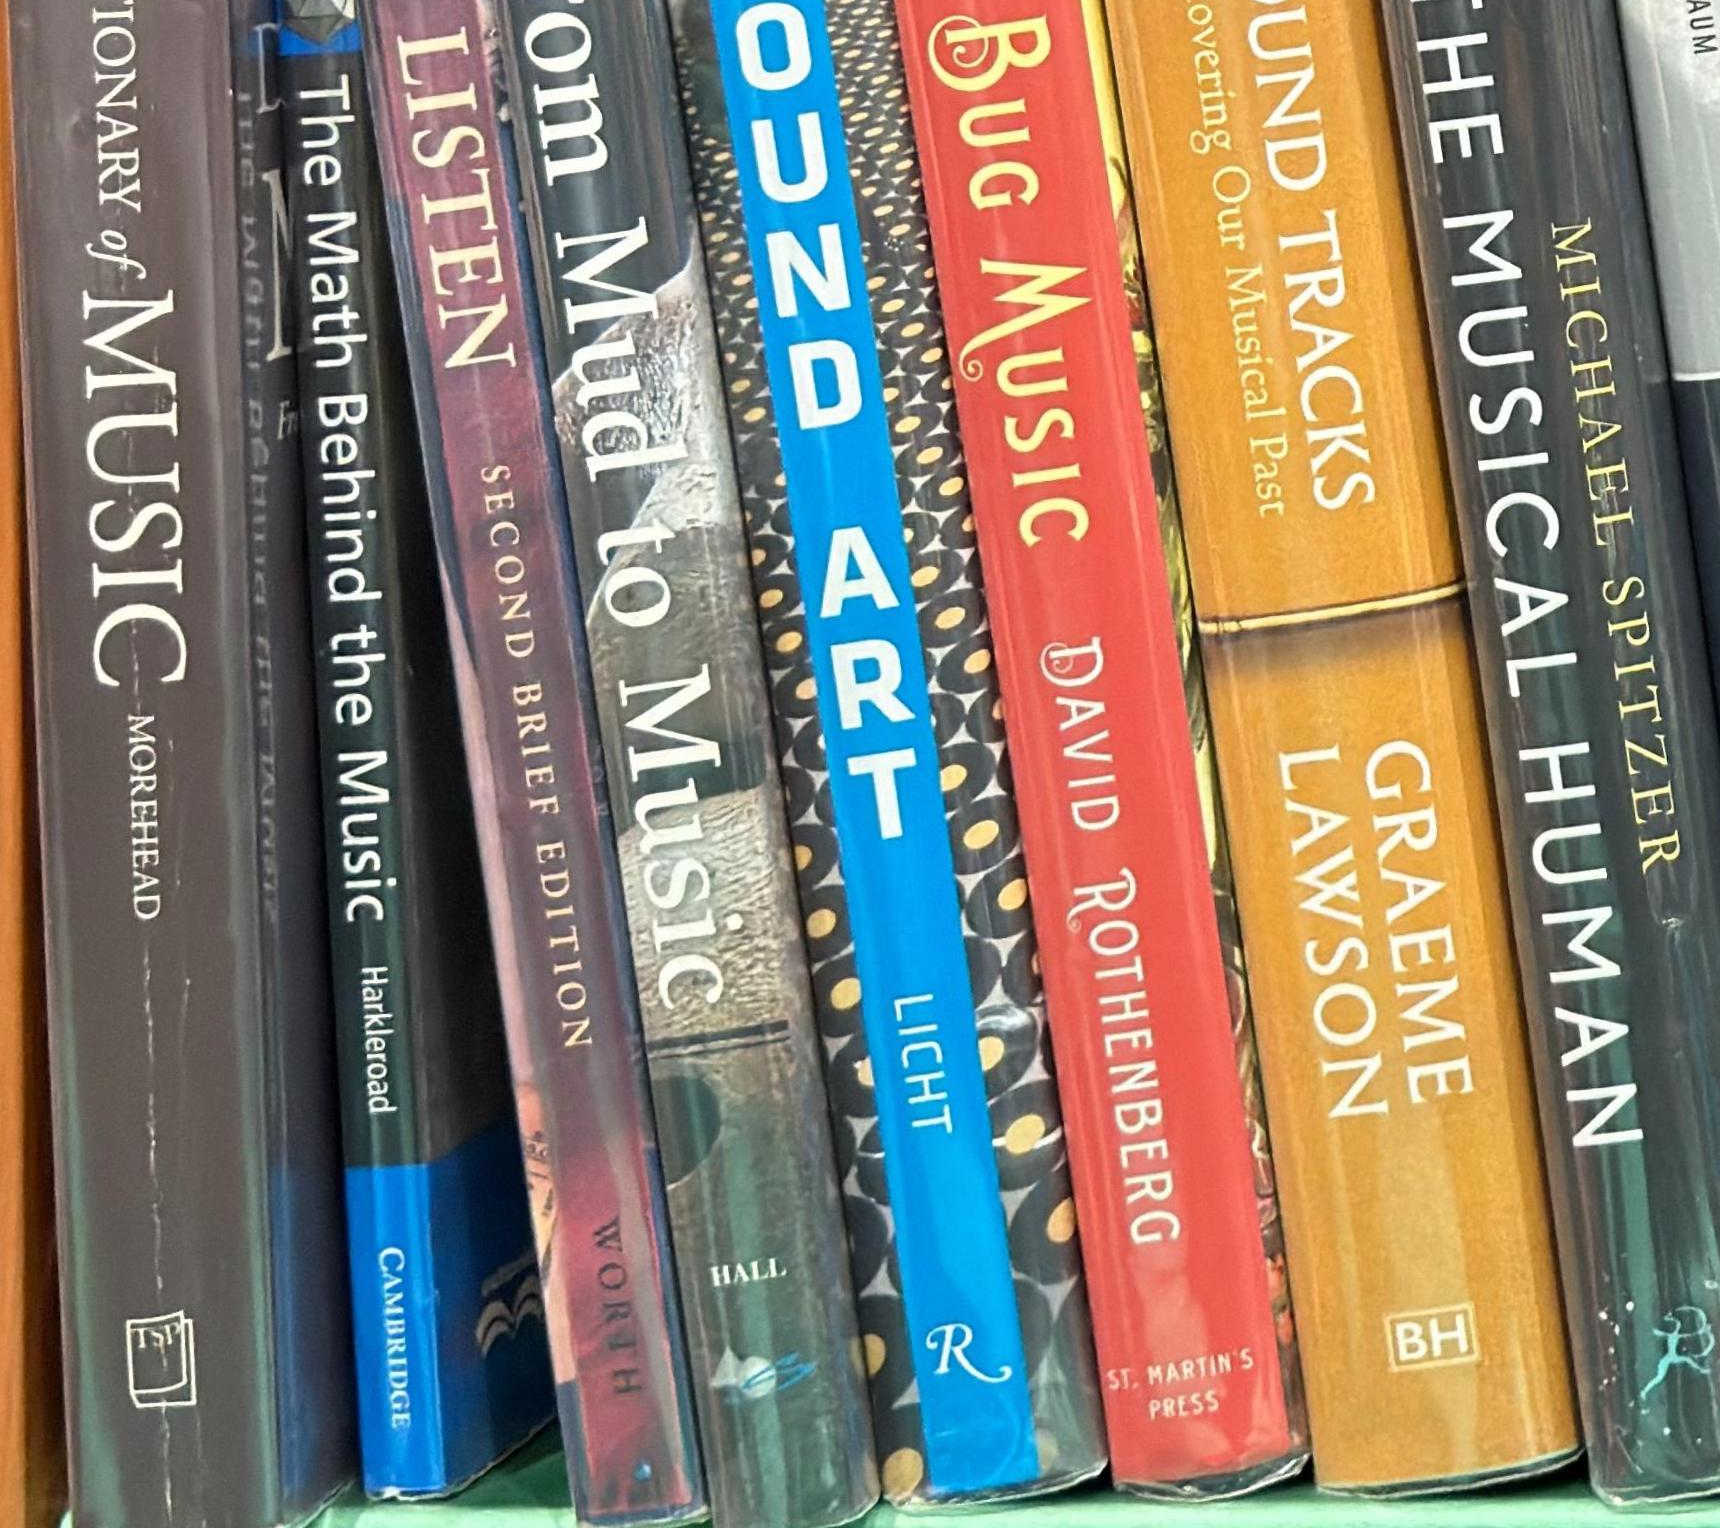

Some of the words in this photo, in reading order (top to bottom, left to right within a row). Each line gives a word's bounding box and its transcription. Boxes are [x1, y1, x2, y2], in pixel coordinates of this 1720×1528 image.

[296, 76, 351, 198] The
[395, 26, 515, 367] LISTEN
[1213, 165, 1253, 252] Our
[88, 229, 147, 280] of
[305, 212, 366, 368] Math
[557, 215, 690, 481] Mud
[1227, 263, 1288, 418] Musical
[1279, 207, 1374, 513] TRACKS
[81, 291, 190, 687] MUSIC
[318, 393, 382, 602] Behind
[1248, 432, 1288, 518] Past
[1550, 216, 1636, 547] MICHAEL
[1603, 578, 1681, 874] SPITZER
[481, 466, 536, 660] SECOND
[596, 518, 672, 629] to
[330, 624, 388, 727] the
[513, 681, 561, 817] BRIEF
[819, 529, 917, 839] ART
[1442, 211, 1577, 699] MUSICAL
[1518, 740, 1644, 1147] HUMAN
[128, 714, 163, 920] MOREHEAD
[334, 752, 398, 922] Music
[619, 665, 745, 1009] Music
[536, 841, 592, 1048] EDITION
[1279, 745, 1389, 1121] LAWSON
[1365, 740, 1472, 1102] GRAEME
[359, 967, 398, 1114] Harkleroad
[893, 992, 952, 1136] LICHT
[592, 1216, 641, 1394] WORTH
[711, 1257, 788, 1289] HALL
[1396, 1314, 1468, 1361] BH
[1107, 1367, 1141, 1391] ST.
[1147, 1347, 1254, 1386] MARTIN'S
[1148, 1390, 1219, 1420] PRESS
